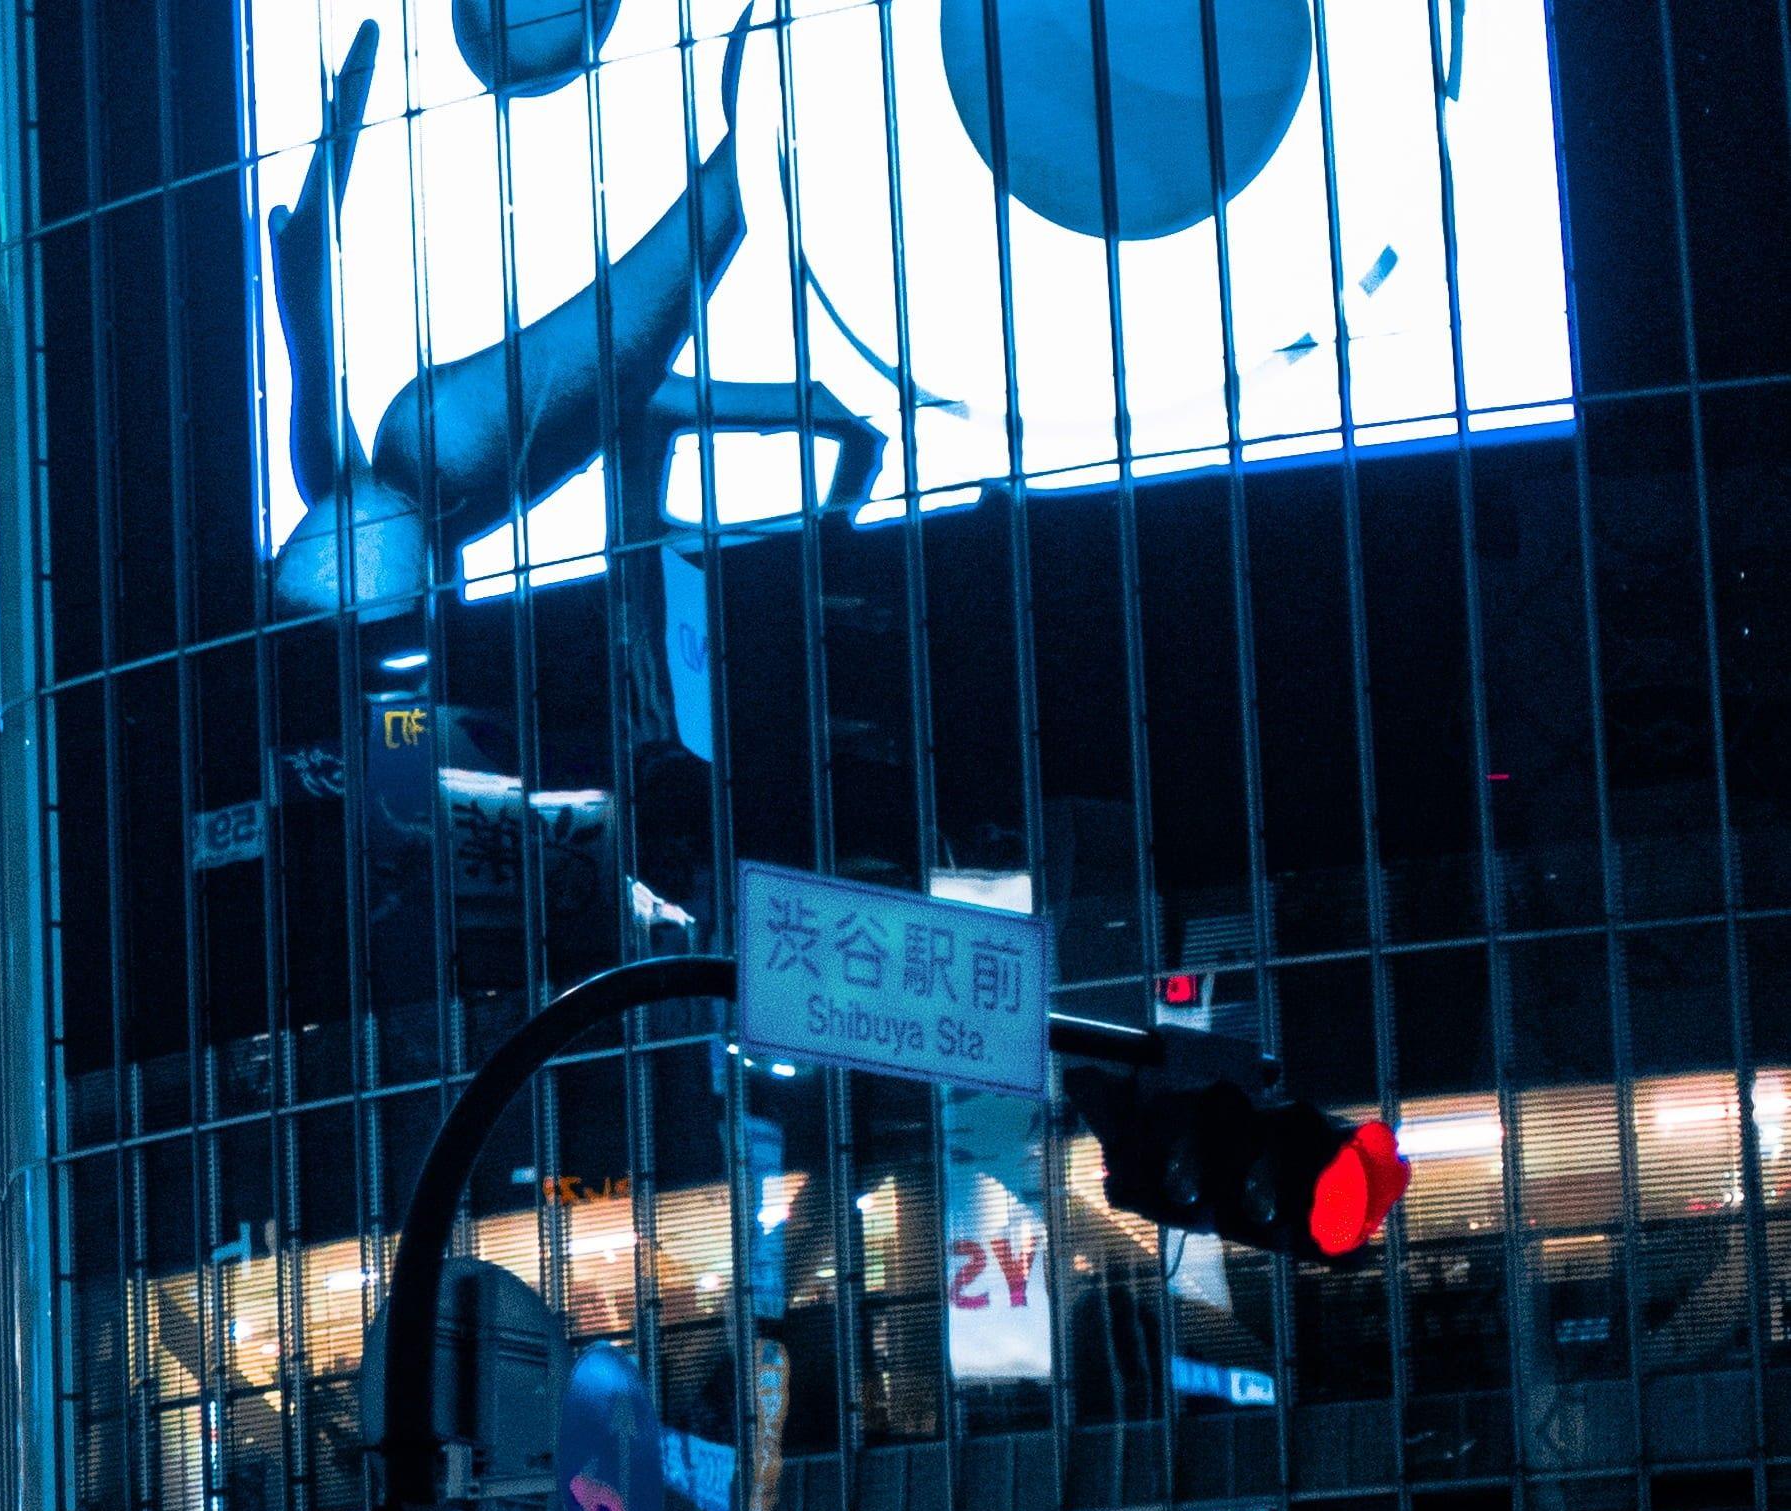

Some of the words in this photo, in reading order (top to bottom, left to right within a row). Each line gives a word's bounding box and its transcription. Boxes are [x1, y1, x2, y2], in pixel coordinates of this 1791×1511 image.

[766, 895, 1025, 1015] 渋谷駅前
[807, 992, 927, 1055] Shibuya
[936, 1013, 987, 1060] Sta.
